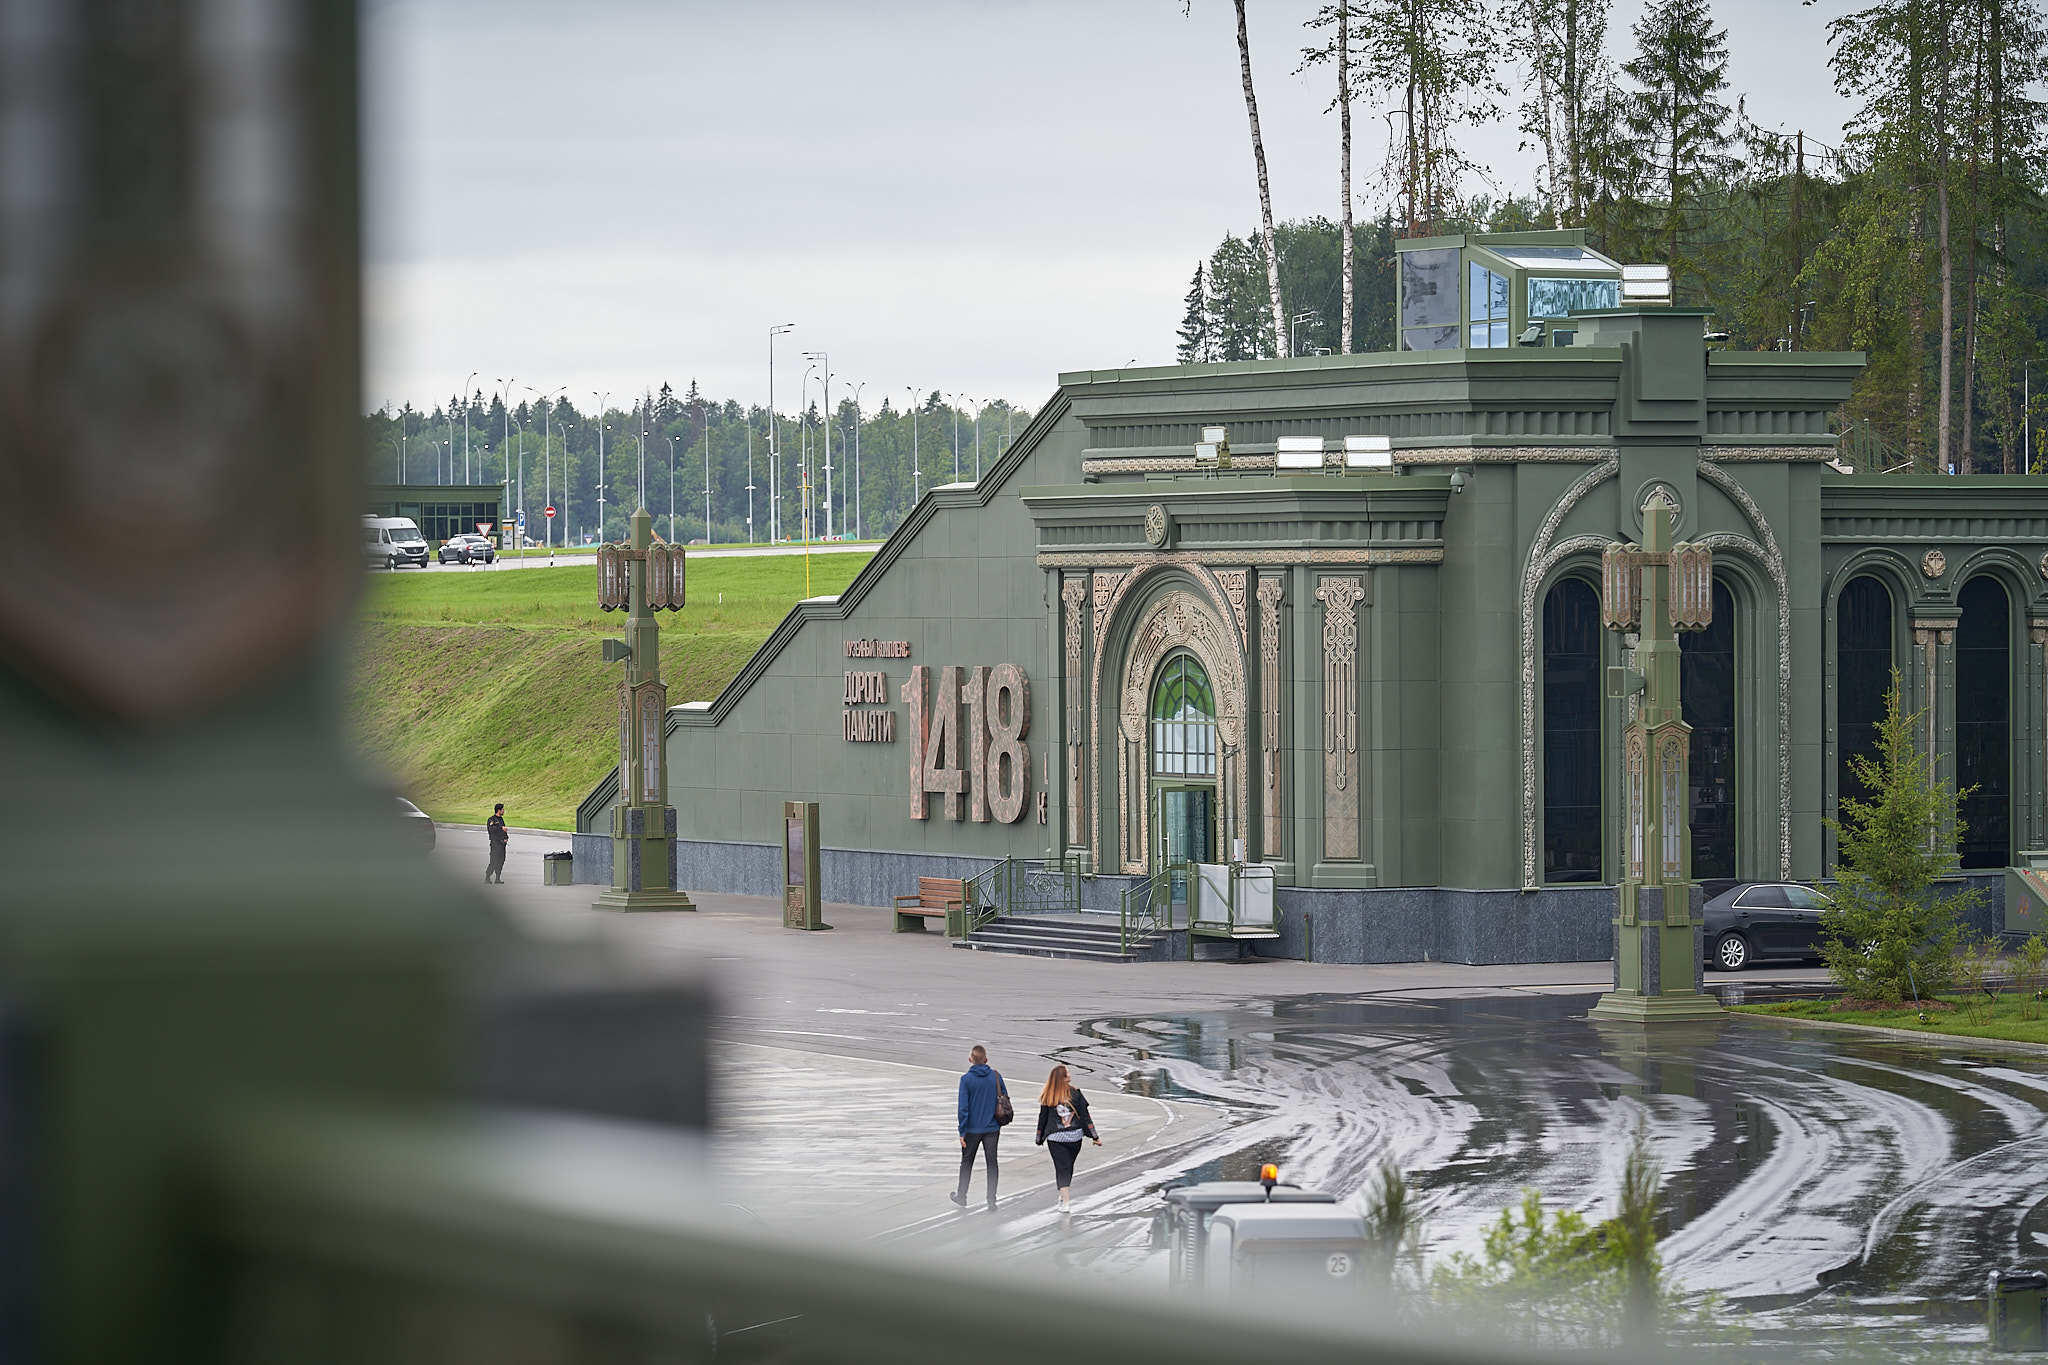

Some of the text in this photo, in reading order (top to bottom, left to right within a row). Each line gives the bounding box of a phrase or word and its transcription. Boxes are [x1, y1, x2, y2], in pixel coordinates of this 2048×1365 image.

[843, 671, 888, 706] ДОРОГА
[843, 710, 896, 743] ПАМЯТИ
[901, 663, 1032, 824] 1418
[1330, 1256, 1347, 1273] 25
